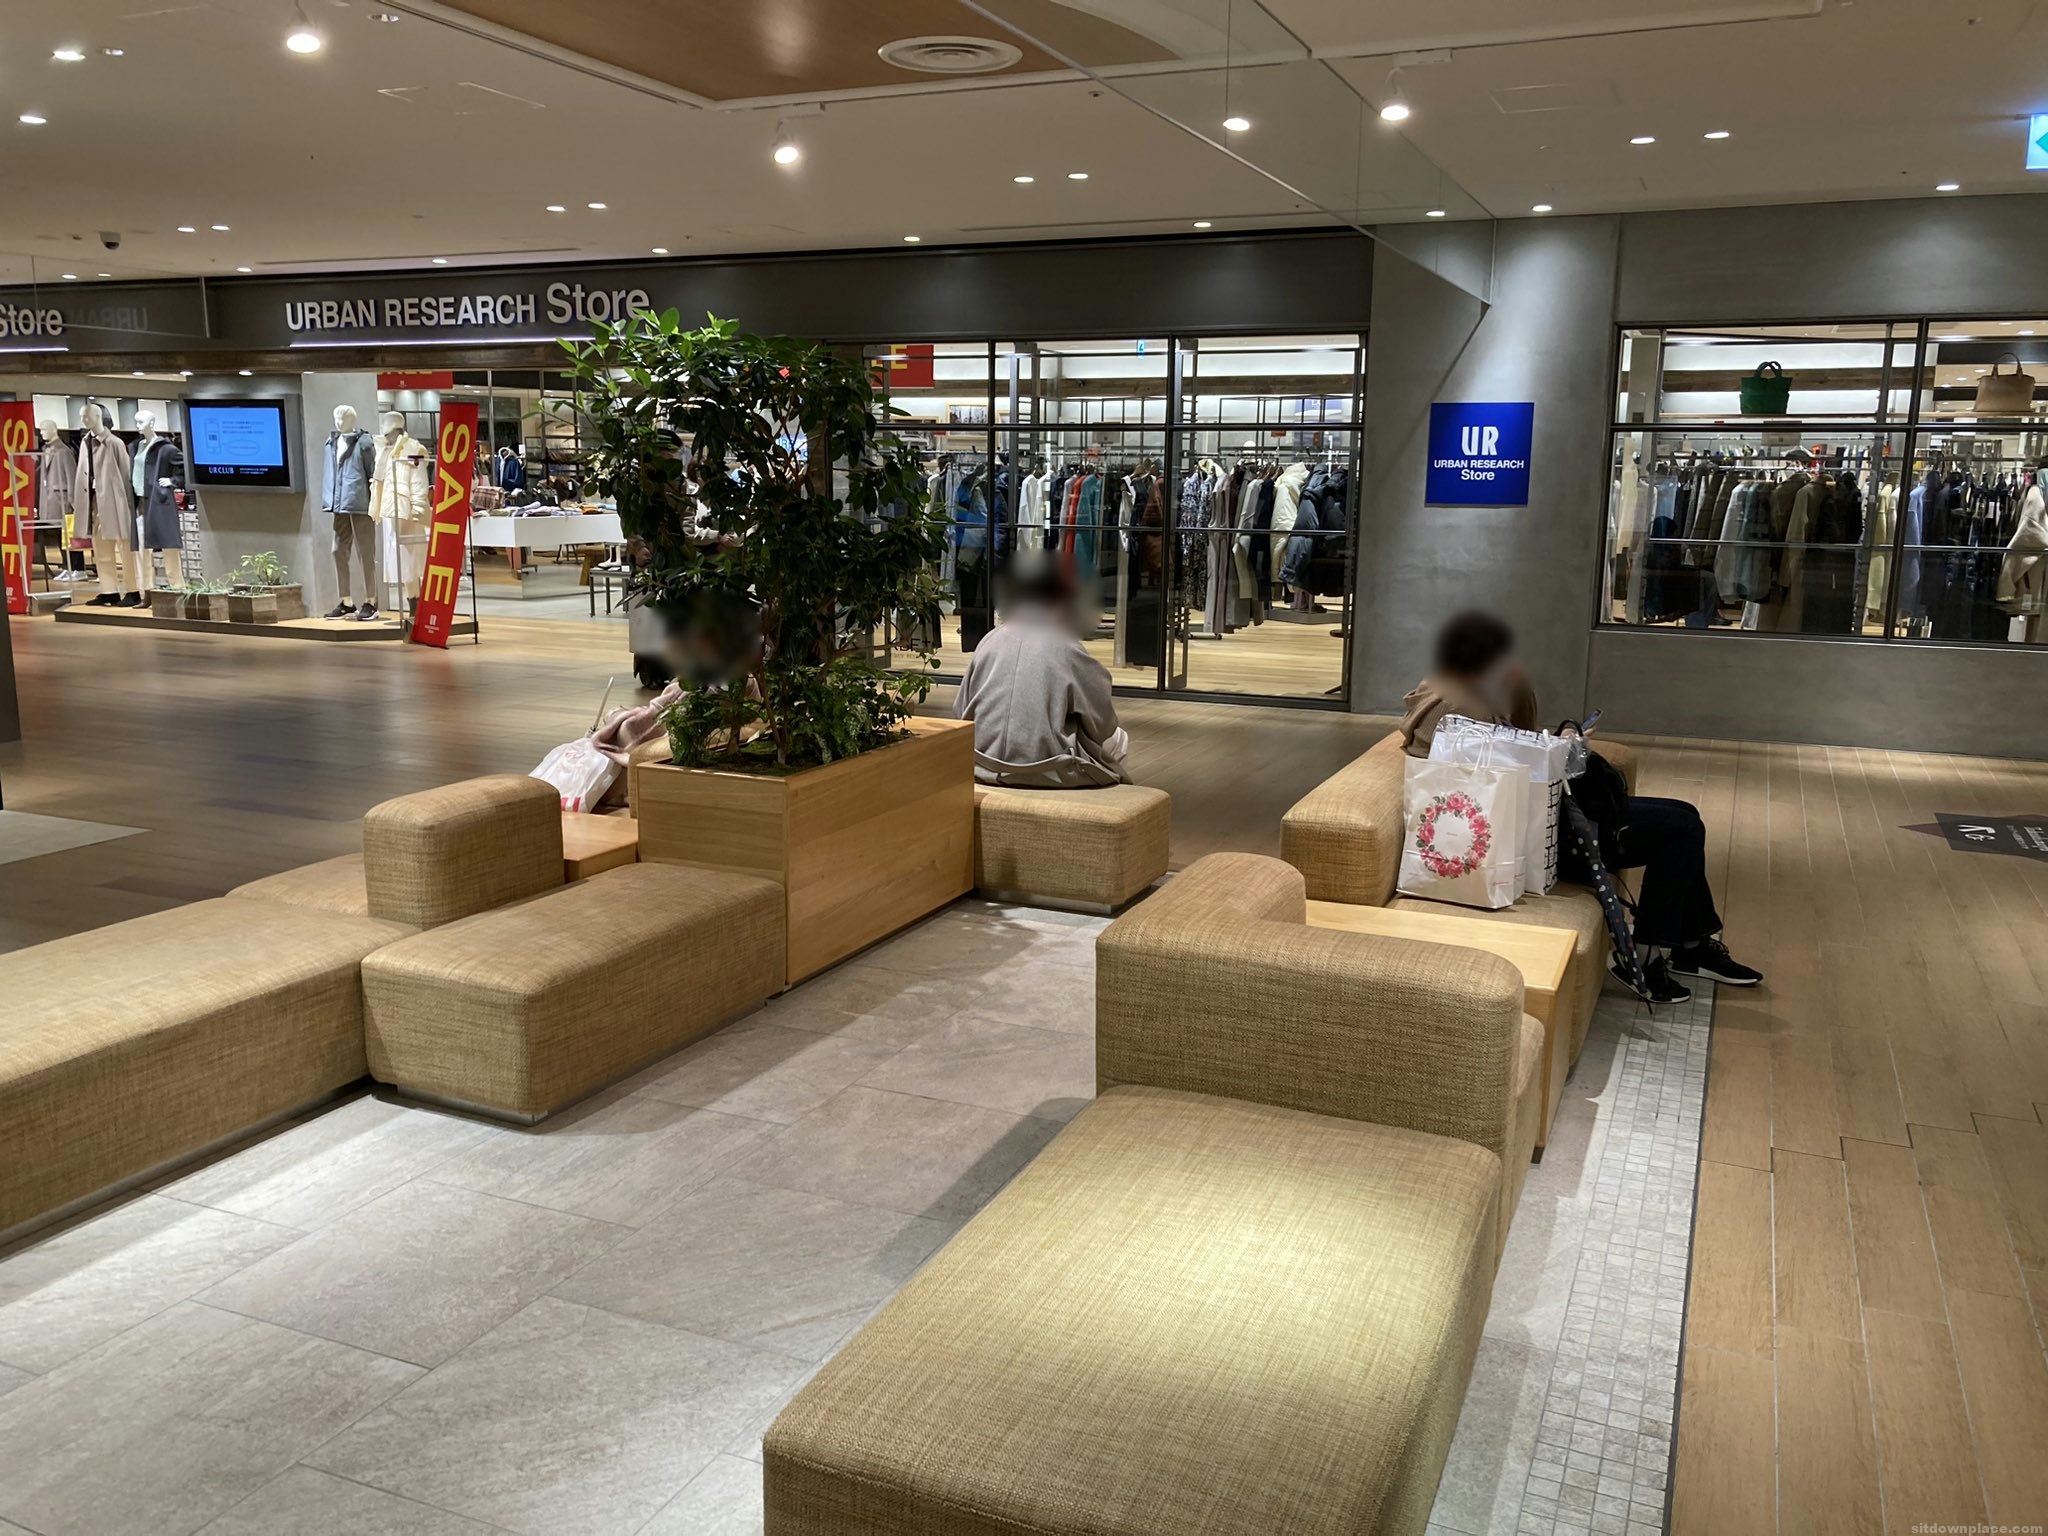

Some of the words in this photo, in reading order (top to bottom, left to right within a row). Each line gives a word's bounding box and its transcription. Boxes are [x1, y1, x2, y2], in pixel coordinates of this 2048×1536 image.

[285, 299, 375, 330] URBAN
[384, 294, 536, 327] RESEARCH
[547, 282, 650, 323] Store
[1461, 426, 1499, 456] UR
[1434, 460, 1468, 468] URBAN
[1470, 460, 1524, 469] RESEARCH
[1461, 469, 1495, 481] Store
[2, 417, 29, 580] SALE
[424, 421, 471, 605] SALE
